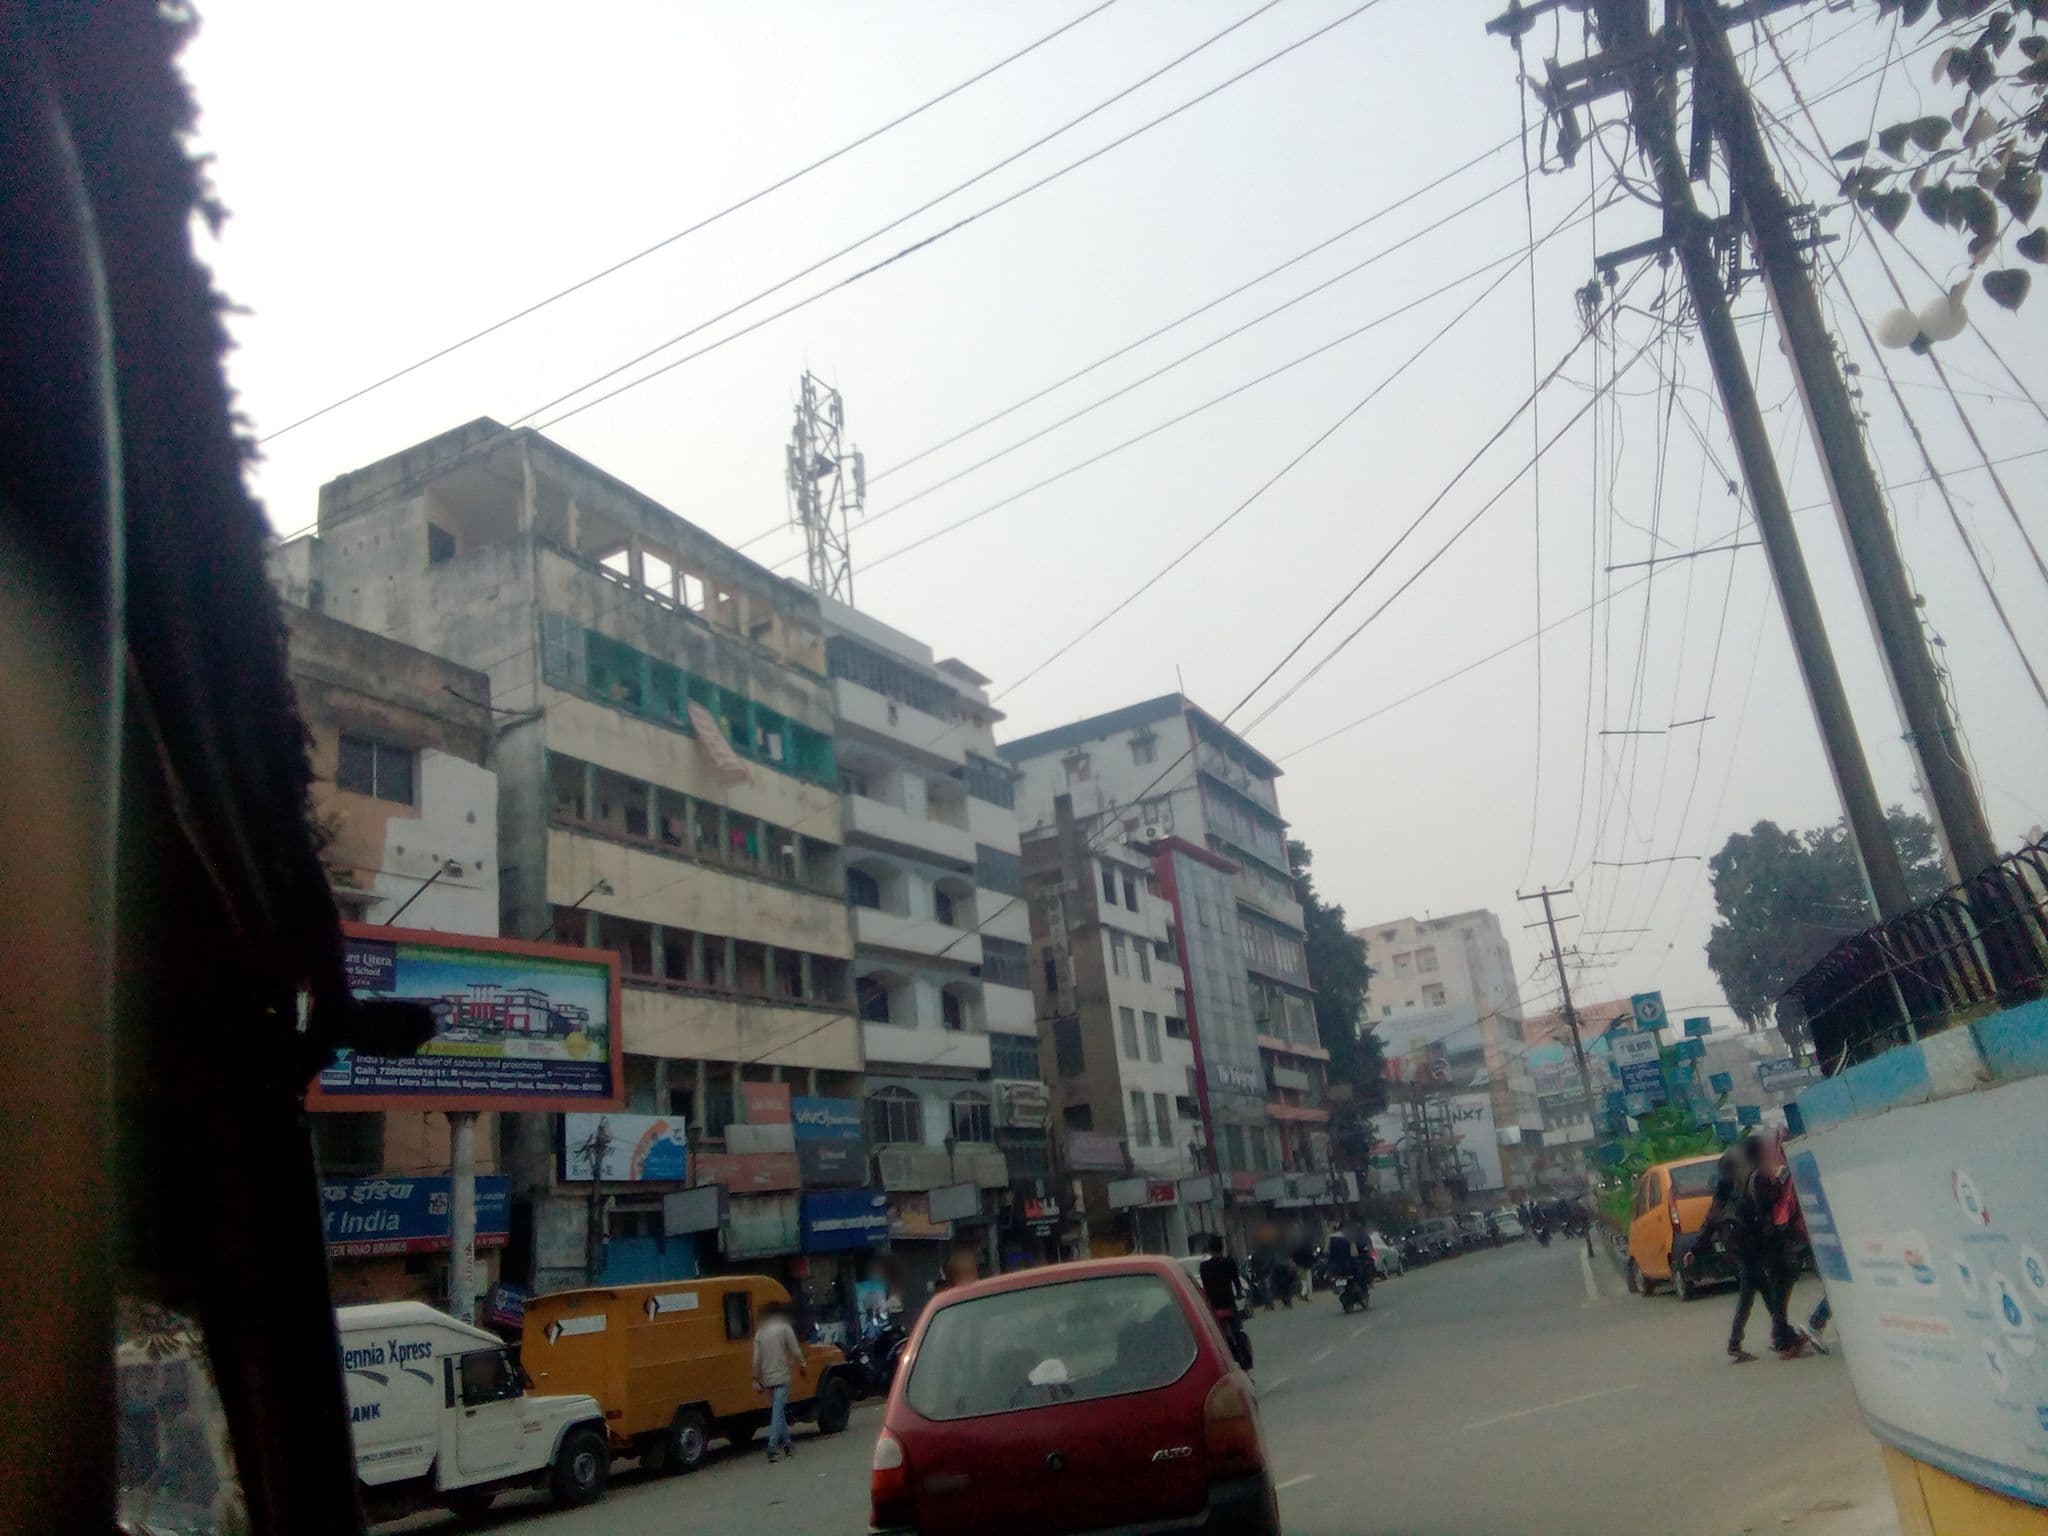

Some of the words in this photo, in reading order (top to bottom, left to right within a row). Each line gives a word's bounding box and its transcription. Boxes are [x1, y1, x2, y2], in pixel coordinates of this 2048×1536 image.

[363, 952, 393, 968] Litera
[355, 966, 382, 976] School
[453, 1057, 484, 1069] schools
[485, 1058, 501, 1069] and
[502, 1060, 543, 1071] preschools
[350, 1179, 415, 1205] इंडिया
[340, 1208, 400, 1234] India
[346, 1244, 371, 1257] ROAD
[373, 1242, 407, 1255] BRANCH
[388, 1338, 433, 1366] Xpress
[352, 1402, 381, 1423] ANK
